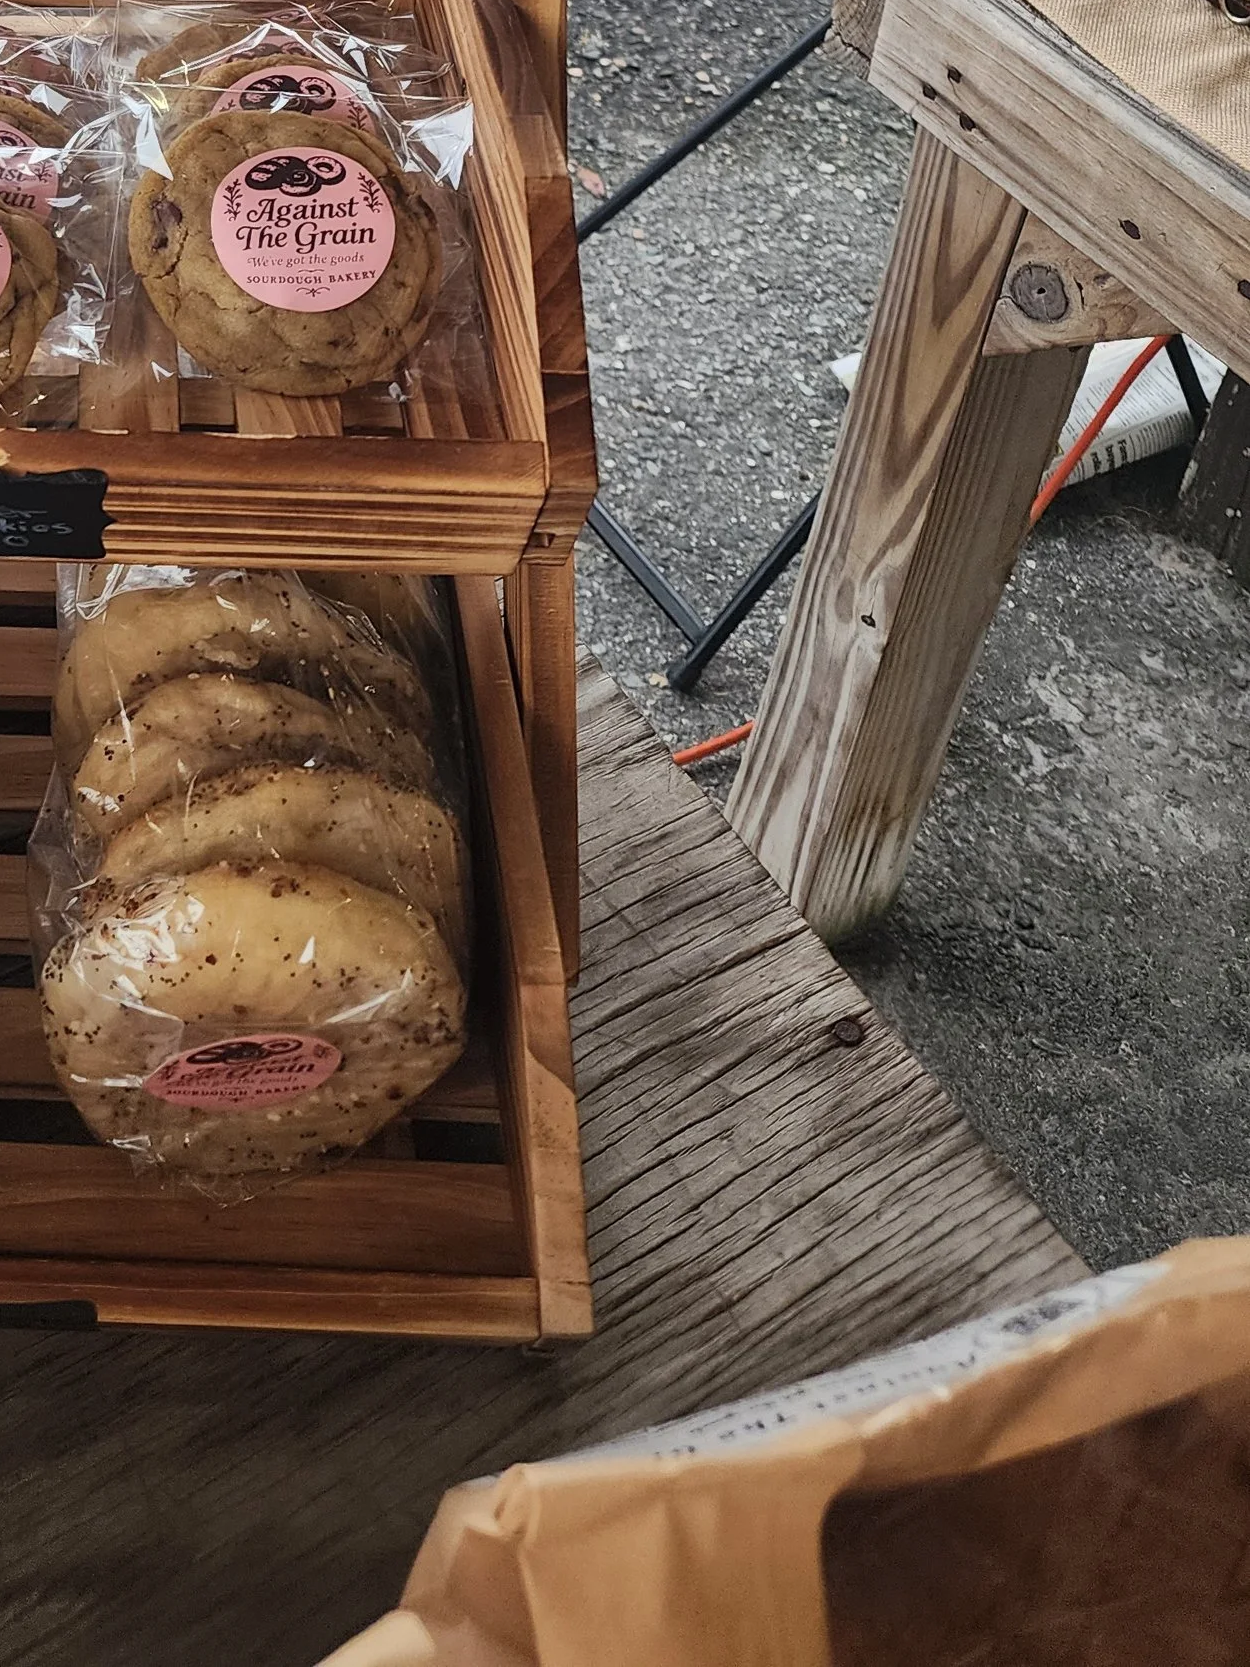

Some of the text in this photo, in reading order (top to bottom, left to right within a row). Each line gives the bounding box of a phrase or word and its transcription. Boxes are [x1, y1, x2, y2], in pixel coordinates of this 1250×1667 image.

[247, 196, 359, 227] Against
[236, 222, 377, 254] The Grain
[285, 256, 307, 267] got
[308, 254, 328, 265] the
[330, 252, 365, 266] goods
[246, 270, 377, 285] SOURDOUGH BAKERY
